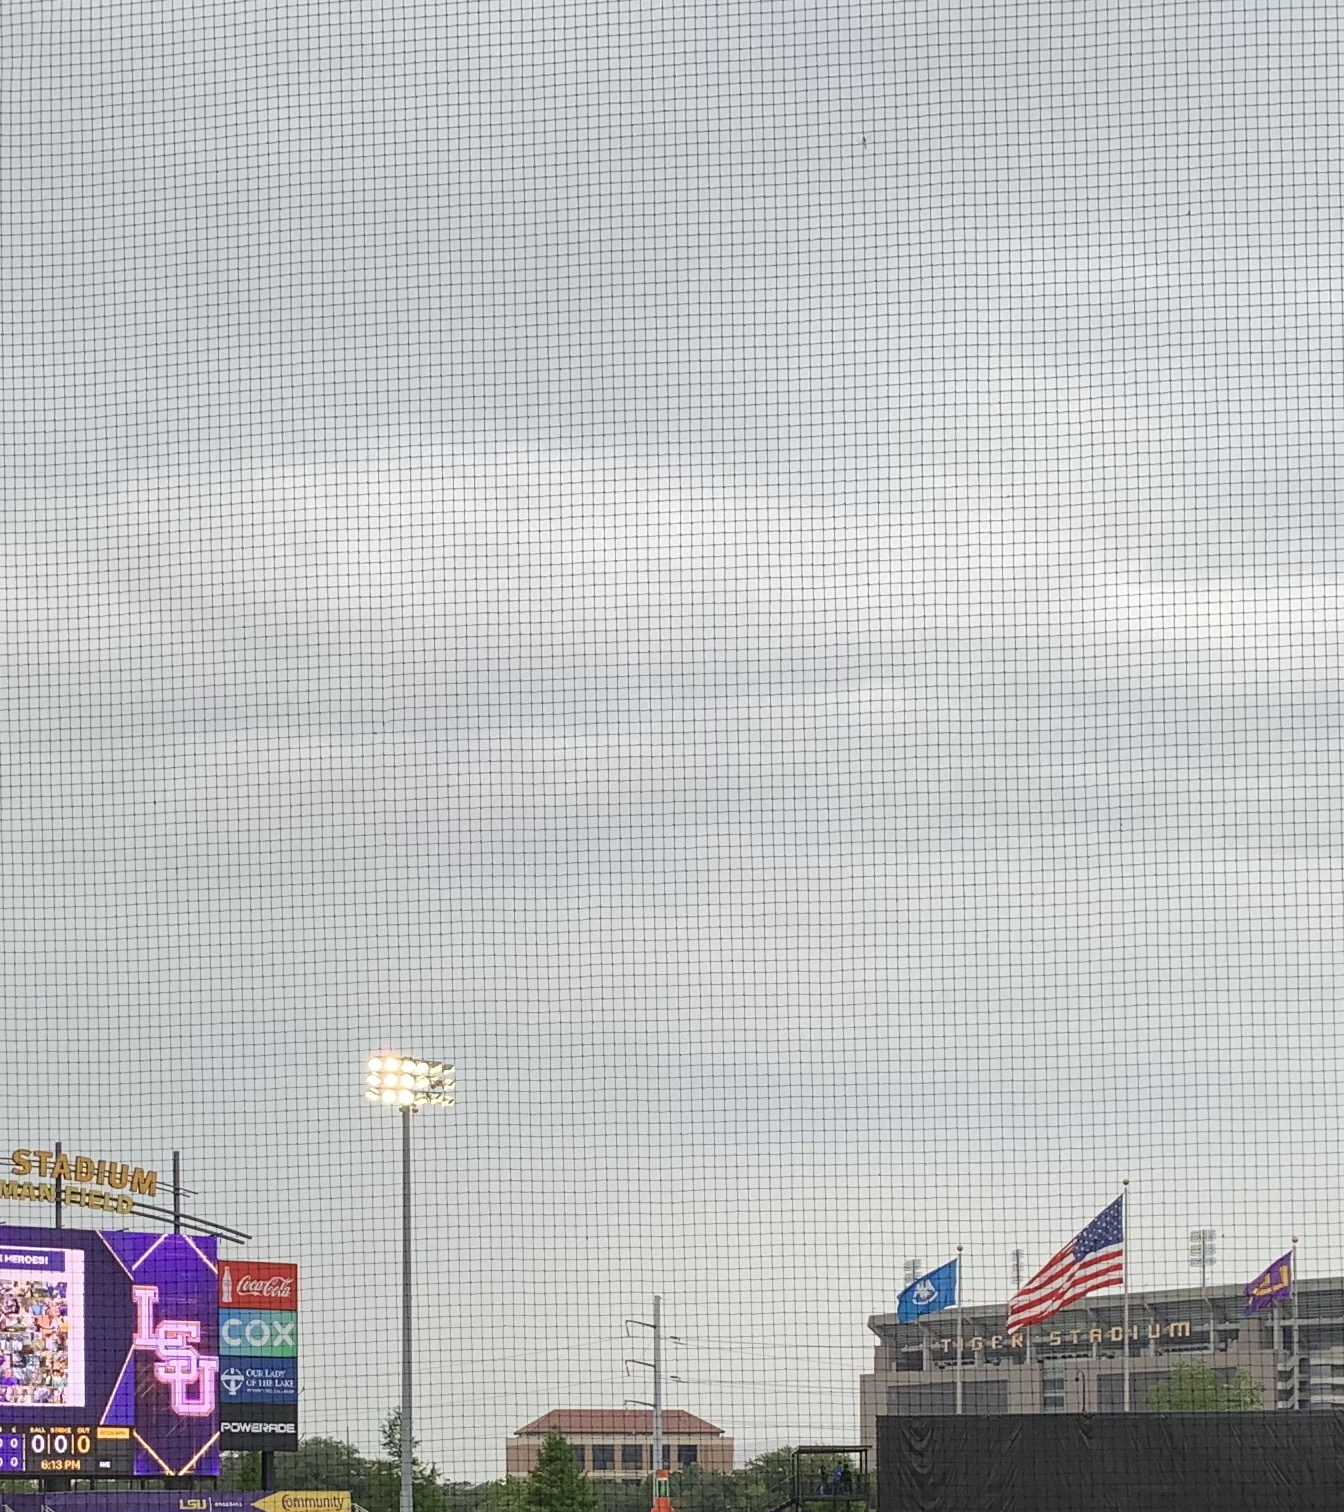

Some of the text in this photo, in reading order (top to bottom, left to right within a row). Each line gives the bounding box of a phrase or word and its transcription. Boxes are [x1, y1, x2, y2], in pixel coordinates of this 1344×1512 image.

[11, 1149, 157, 1197] STADIUM
[64, 1185, 135, 1215] FIELD
[4, 1252, 49, 1265] HEROES!
[222, 1318, 295, 1348] COX
[940, 1321, 1191, 1352] TGER STADIUM
[132, 1285, 219, 1417] LSU
[246, 1369, 286, 1378] OUR LADY
[246, 1379, 294, 1388] OF THE LAKE
[221, 1422, 296, 1433] POWERADE
[10, 1438, 18, 1448] 0
[32, 1434, 91, 1454] 0 0 0
[10, 1457, 18, 1467] 0
[41, 1459, 80, 1470] 6:13 PM
[179, 1499, 206, 1510] LSU
[282, 1494, 344, 1510] Community
